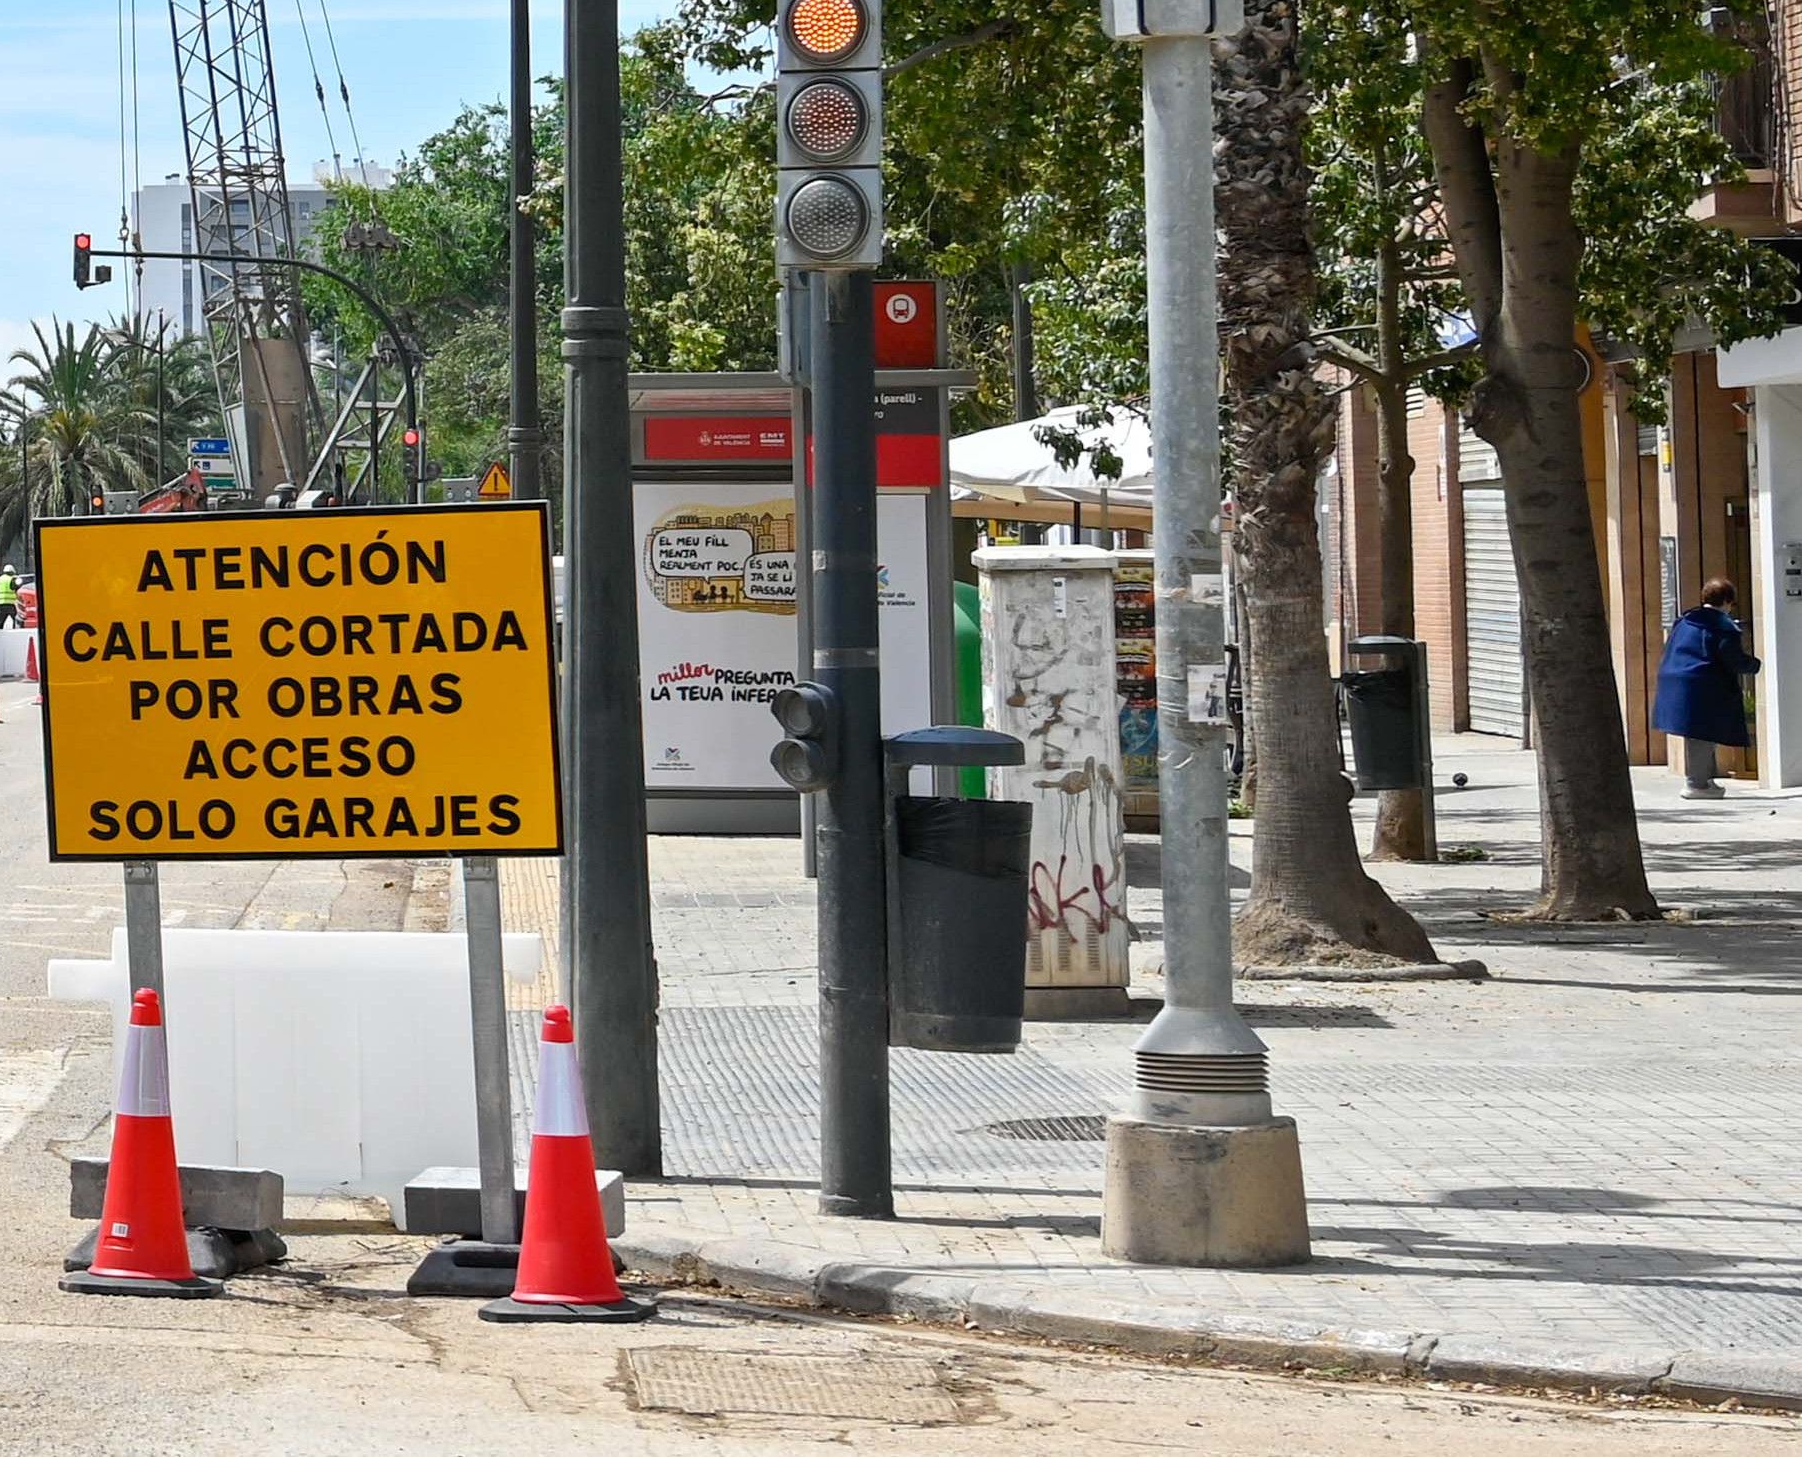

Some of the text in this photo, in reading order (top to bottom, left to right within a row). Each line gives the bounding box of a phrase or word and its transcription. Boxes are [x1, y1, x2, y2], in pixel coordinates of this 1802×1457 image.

[880, 393, 916, 405] (parell)
[659, 536, 671, 546] EL
[676, 537, 699, 546] MEU
[137, 530, 446, 592] ATENCIÓN
[660, 561, 713, 571] REALMENT
[767, 560, 789, 570] UNA
[767, 573, 779, 582] SE
[63, 611, 528, 662] CALLE CORTADA
[658, 662, 795, 685] millor PREGUNTA
[130, 673, 462, 721] POR OBRAS
[651, 686, 670, 701] LA
[676, 686, 723, 702] TEUA
[183, 736, 416, 780] ACCESO
[88, 794, 521, 841] SOLO GARAJES
